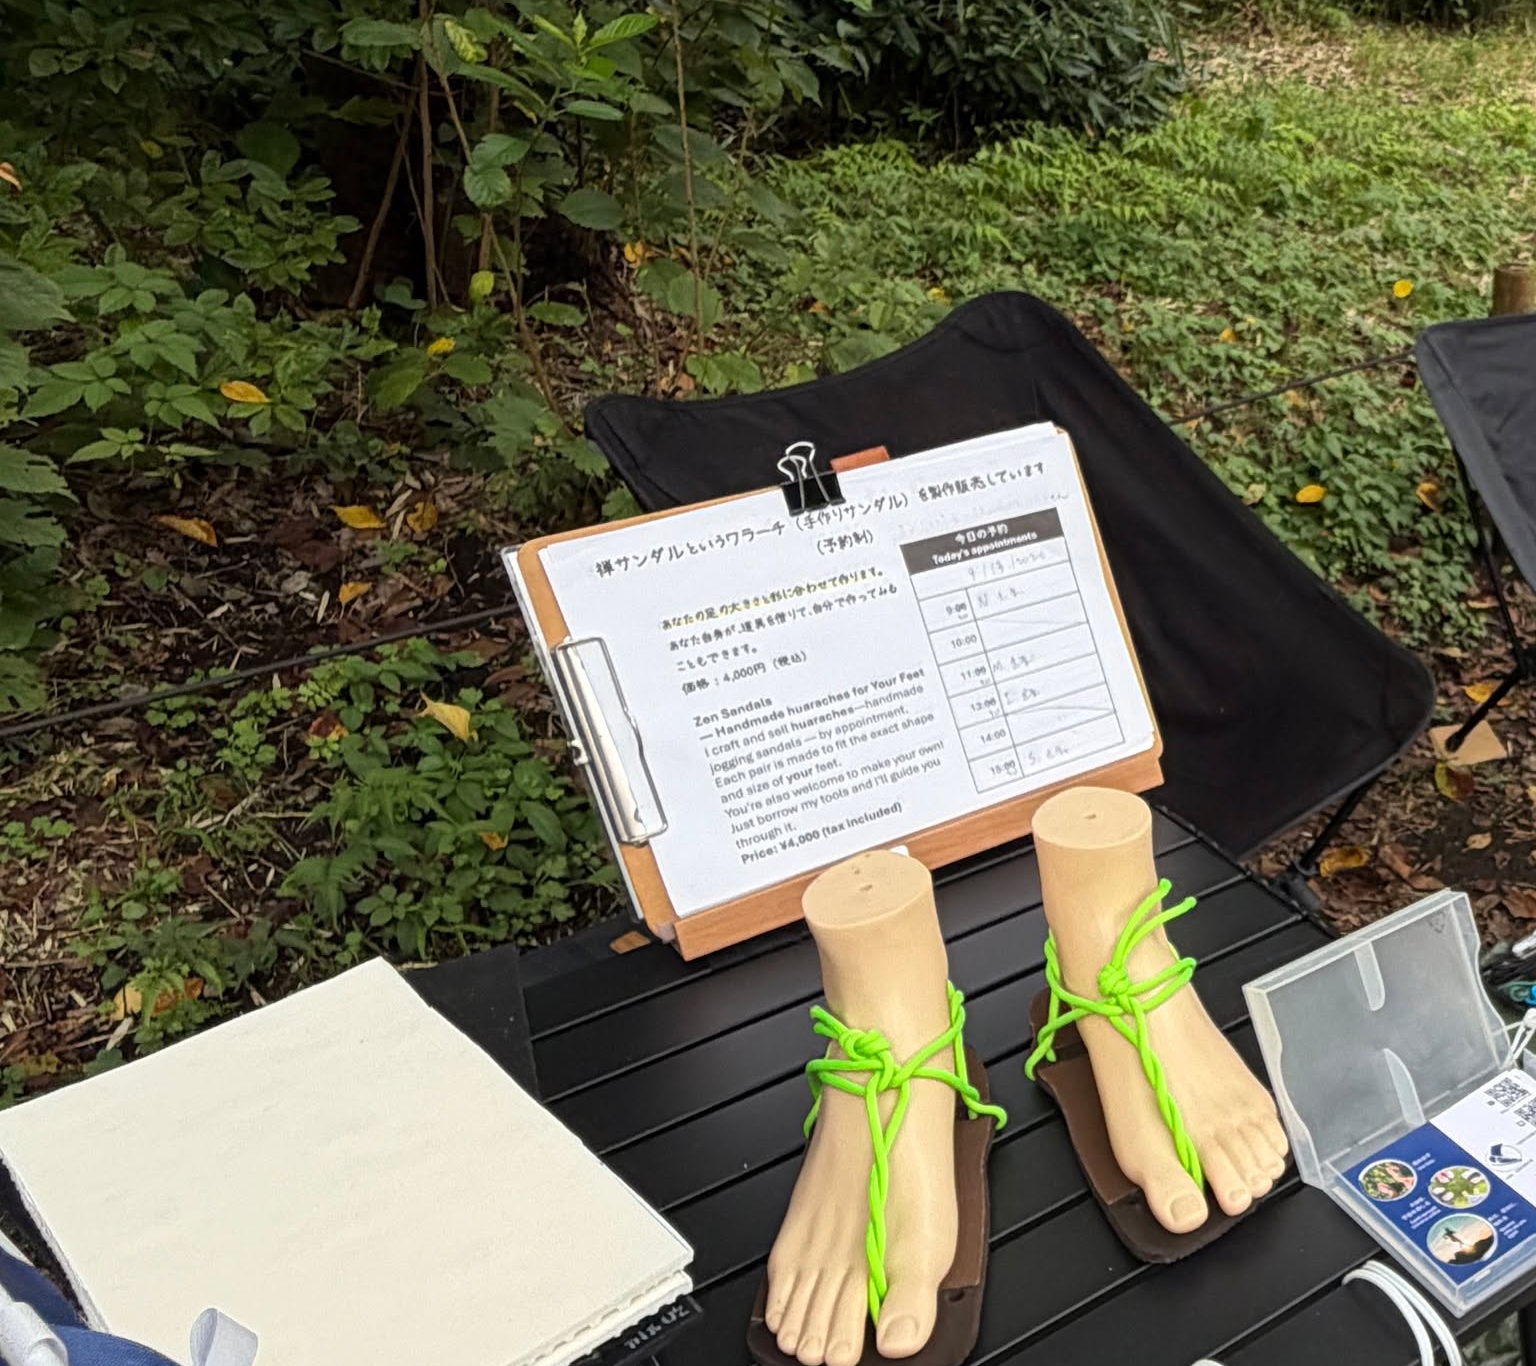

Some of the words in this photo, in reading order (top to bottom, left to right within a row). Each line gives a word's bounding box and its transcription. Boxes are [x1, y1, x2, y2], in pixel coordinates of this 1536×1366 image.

[931, 546, 971, 566] Today's
[970, 530, 1038, 556] appointments
[954, 523, 1009, 545] 今日の予約
[676, 643, 758, 672] こともできます。
[950, 634, 977, 649] 10:00
[692, 713, 720, 728] Zen
[720, 697, 773, 720] Sandals
[714, 709, 786, 738] Handmade
[786, 690, 851, 716] huaraches
[851, 684, 869, 697] for
[869, 676, 897, 691] Your
[898, 668, 925, 684] Feet
[709, 751, 755, 777] jogging
[755, 738, 803, 760] sandals
[817, 728, 833, 740] by
[834, 704, 909, 736] appointment.
[711, 739, 741, 756] craft
[742, 730, 766, 747] and
[767, 723, 790, 739] sell
[714, 770, 746, 789] Each
[747, 762, 771, 780] pair
[772, 759, 785, 771] is
[786, 748, 820, 766] made
[820, 744, 834, 755] to
[834, 738, 848, 751] fit
[848, 733, 868, 747] the
[869, 722, 900, 740] exact
[901, 713, 935, 730] shape
[980, 727, 1007, 744] 14:00
[720, 787, 744, 804] and
[745, 781, 770, 796] size
[771, 774, 784, 788] of
[785, 767, 813, 785] your
[814, 758, 842, 774] feet.
[723, 800, 763, 819] You're
[765, 791, 791, 807] also
[791, 773, 845, 798] welcome
[845, 769, 859, 780] to
[860, 758, 892, 776] make
[891, 749, 916, 767] your
[918, 739, 945, 756] own!
[731, 818, 756, 835] Just
[756, 804, 799, 826] borrow
[800, 798, 819, 811] my
[819, 788, 850, 804] tools
[851, 778, 874, 794] and
[873, 773, 889, 787] I'll
[889, 765, 920, 784] guide
[920, 757, 942, 773] you
[735, 826, 783, 850] through
[783, 822, 797, 833] it.
[740, 845, 779, 865] Price:
[778, 829, 821, 851] ¥4,000
[821, 822, 846, 839] (tax
[845, 801, 903, 828] included)
